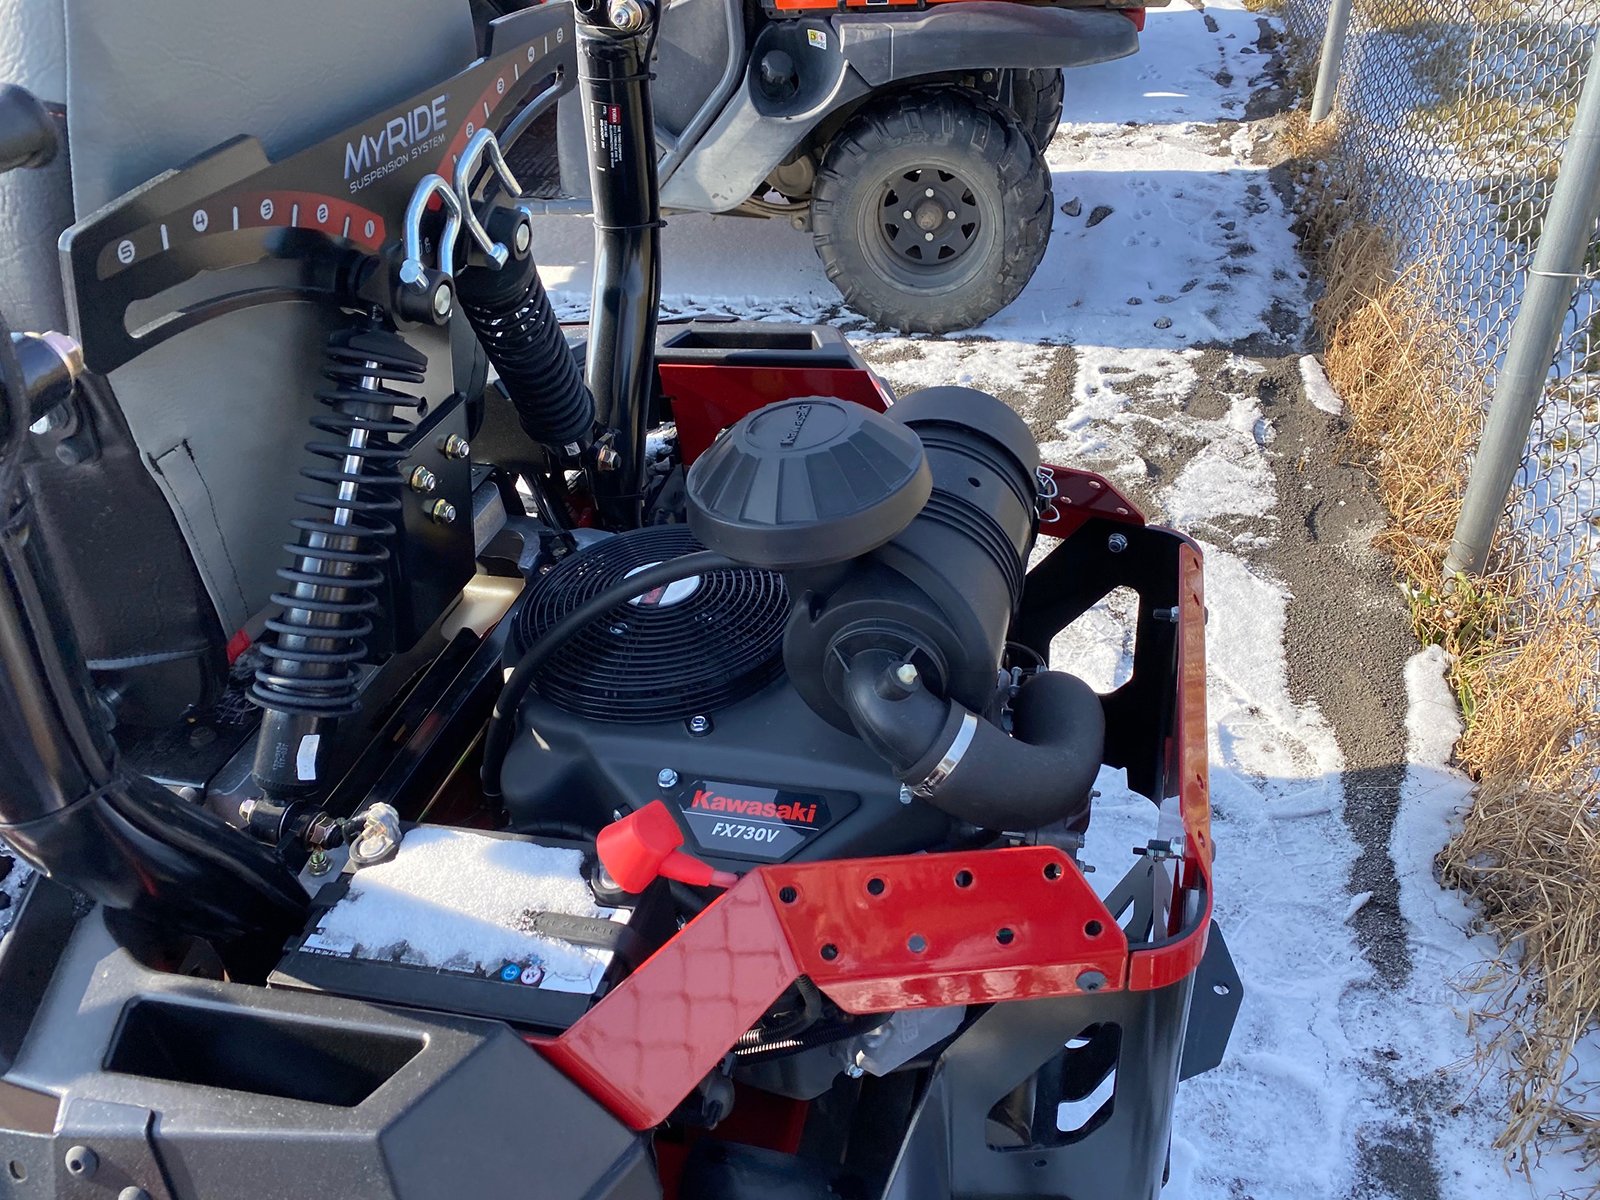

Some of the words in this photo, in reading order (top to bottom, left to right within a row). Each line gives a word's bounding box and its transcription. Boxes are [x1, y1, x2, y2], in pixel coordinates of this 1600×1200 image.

[350, 153, 409, 194] SUSPENSION
[411, 133, 446, 159] SYSTEM
[119, 243, 134, 262] 5
[194, 211, 206, 229] 4
[261, 201, 273, 218] 3
[691, 789, 817, 824] Kawasaki
[712, 822, 780, 843] FX730V
